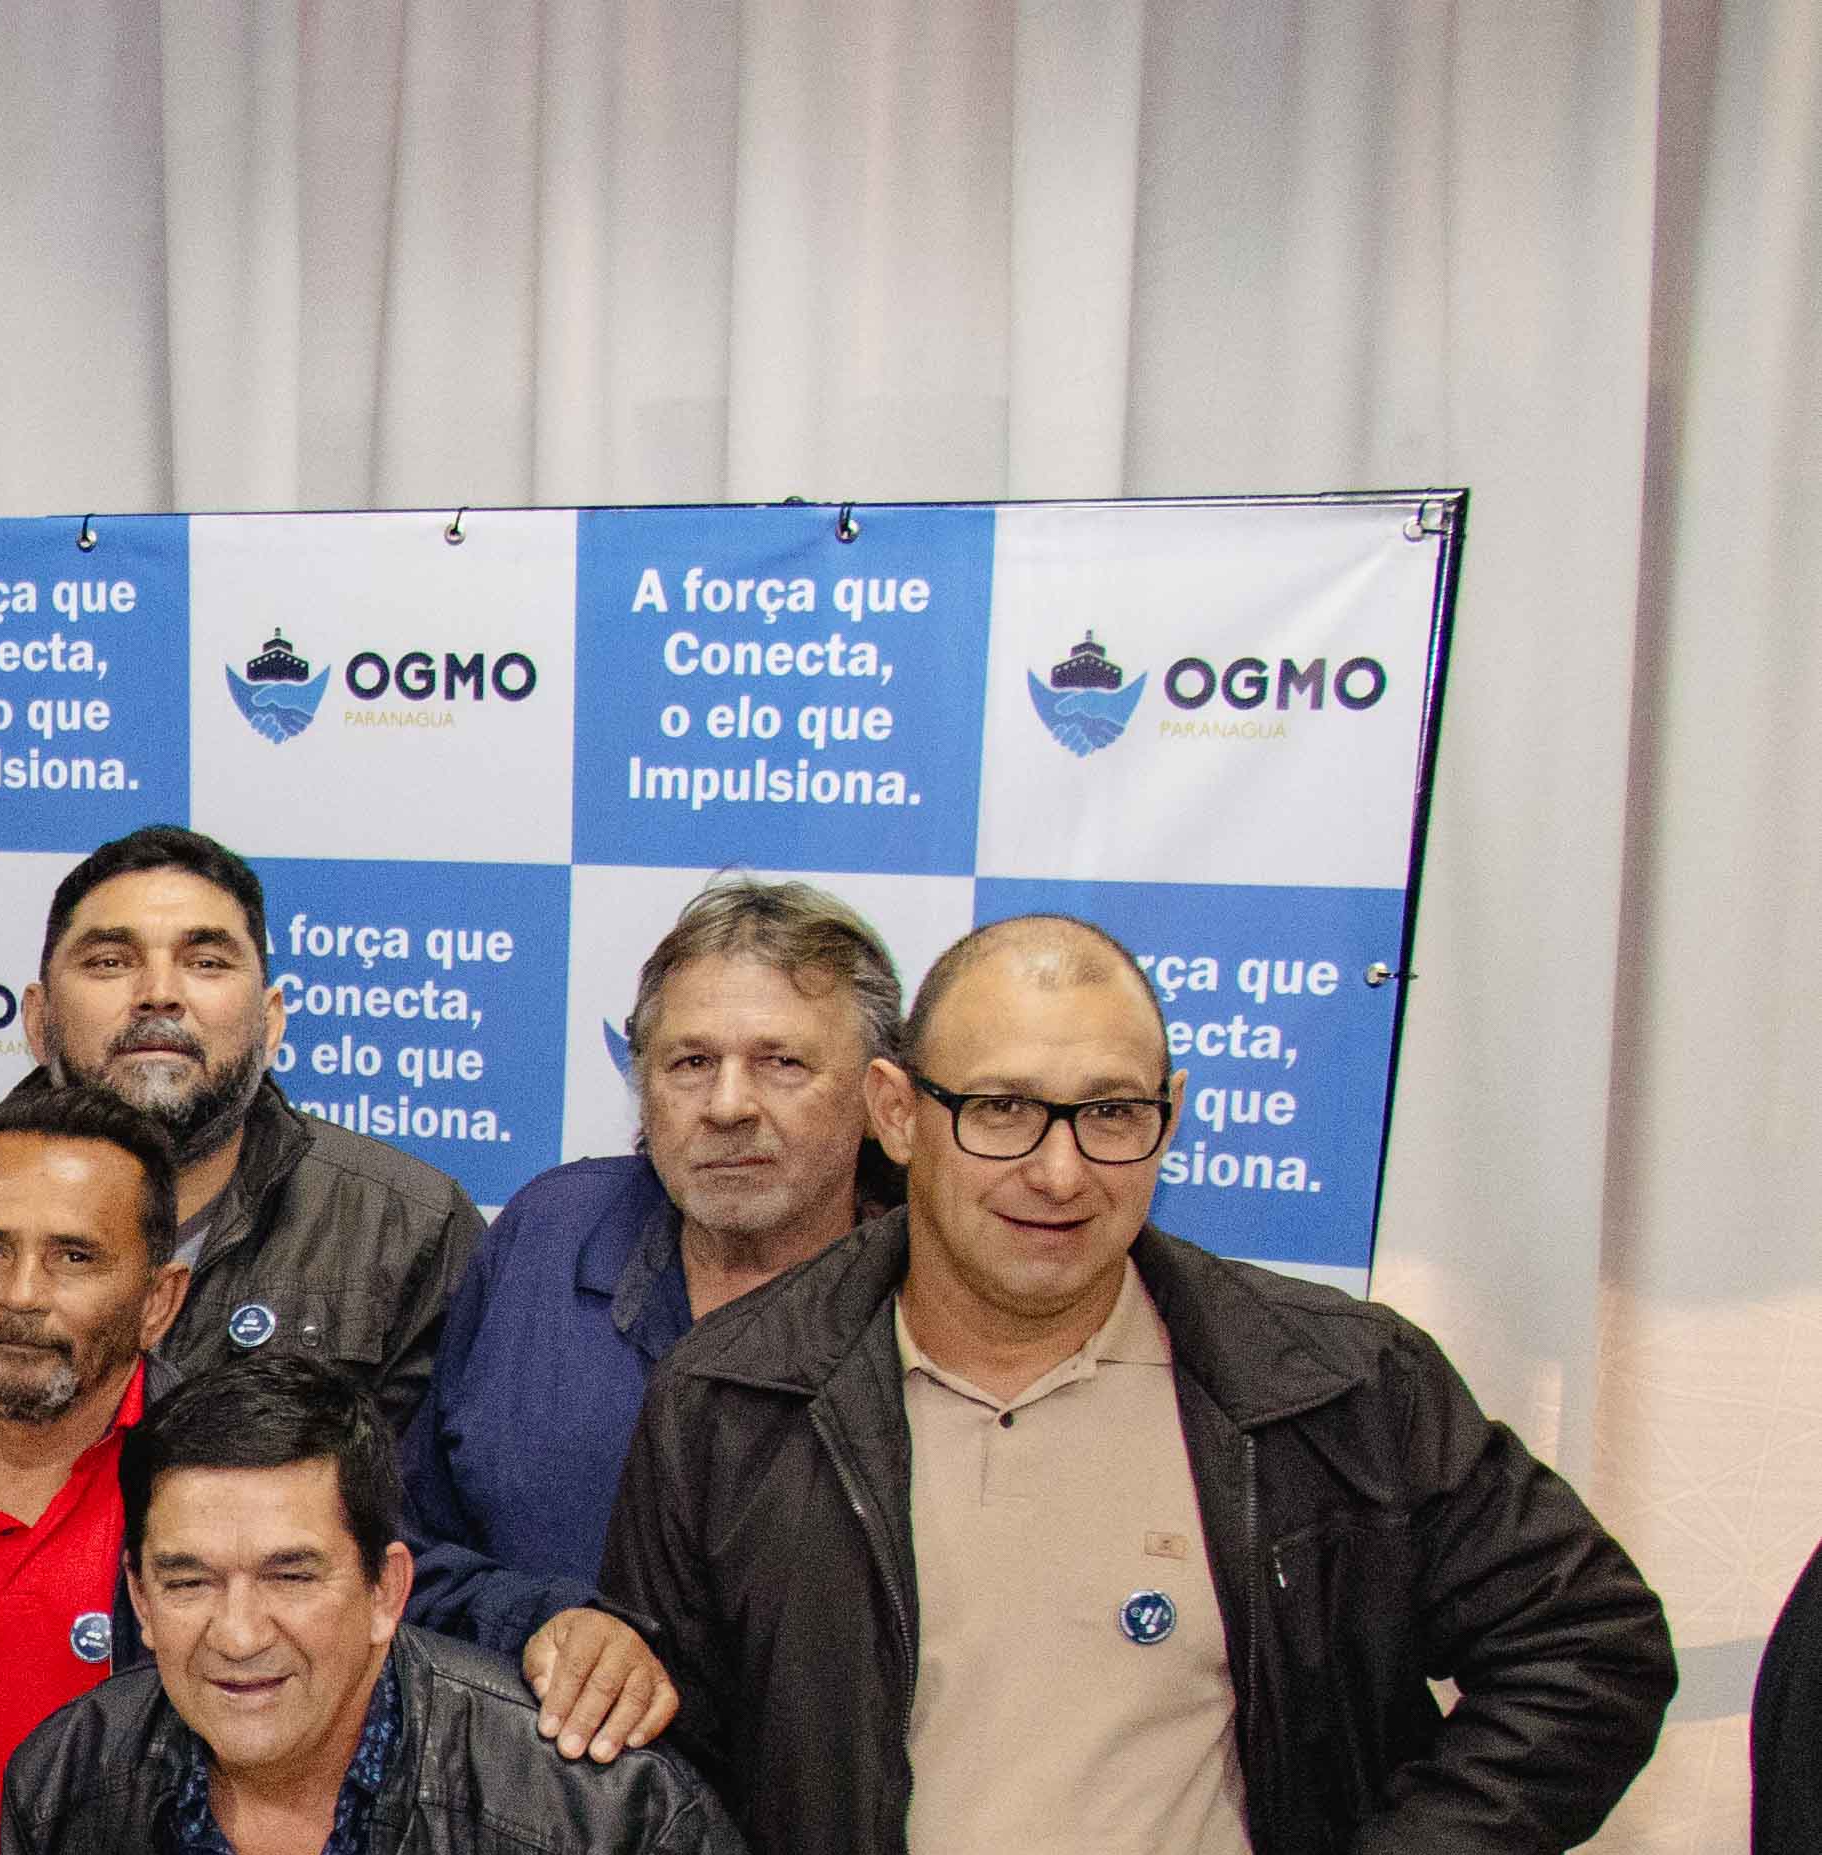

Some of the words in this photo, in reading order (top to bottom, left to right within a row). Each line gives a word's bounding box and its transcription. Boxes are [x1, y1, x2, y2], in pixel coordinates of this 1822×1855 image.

[53, 581, 136, 621] que
[633, 568, 667, 612] A
[684, 567, 815, 624] força
[834, 577, 930, 621] que
[346, 652, 537, 701] OGMO
[665, 631, 893, 684] Conecta,
[1165, 657, 1387, 710] OGMO
[28, 699, 110, 739] que
[661, 704, 691, 737] o
[707, 695, 782, 738] elo
[799, 706, 893, 749] que
[630, 757, 921, 810] Impulsiona.
[289, 912, 409, 969] força
[427, 929, 513, 970] que
[281, 974, 485, 1029] Conecta,
[1239, 959, 1339, 1003] que
[311, 1036, 382, 1076] elo
[397, 1046, 484, 1084] que
[1166, 1014, 1297, 1070] ecta,
[1196, 1088, 1296, 1132] que
[1159, 1140, 1322, 1193] siona.
